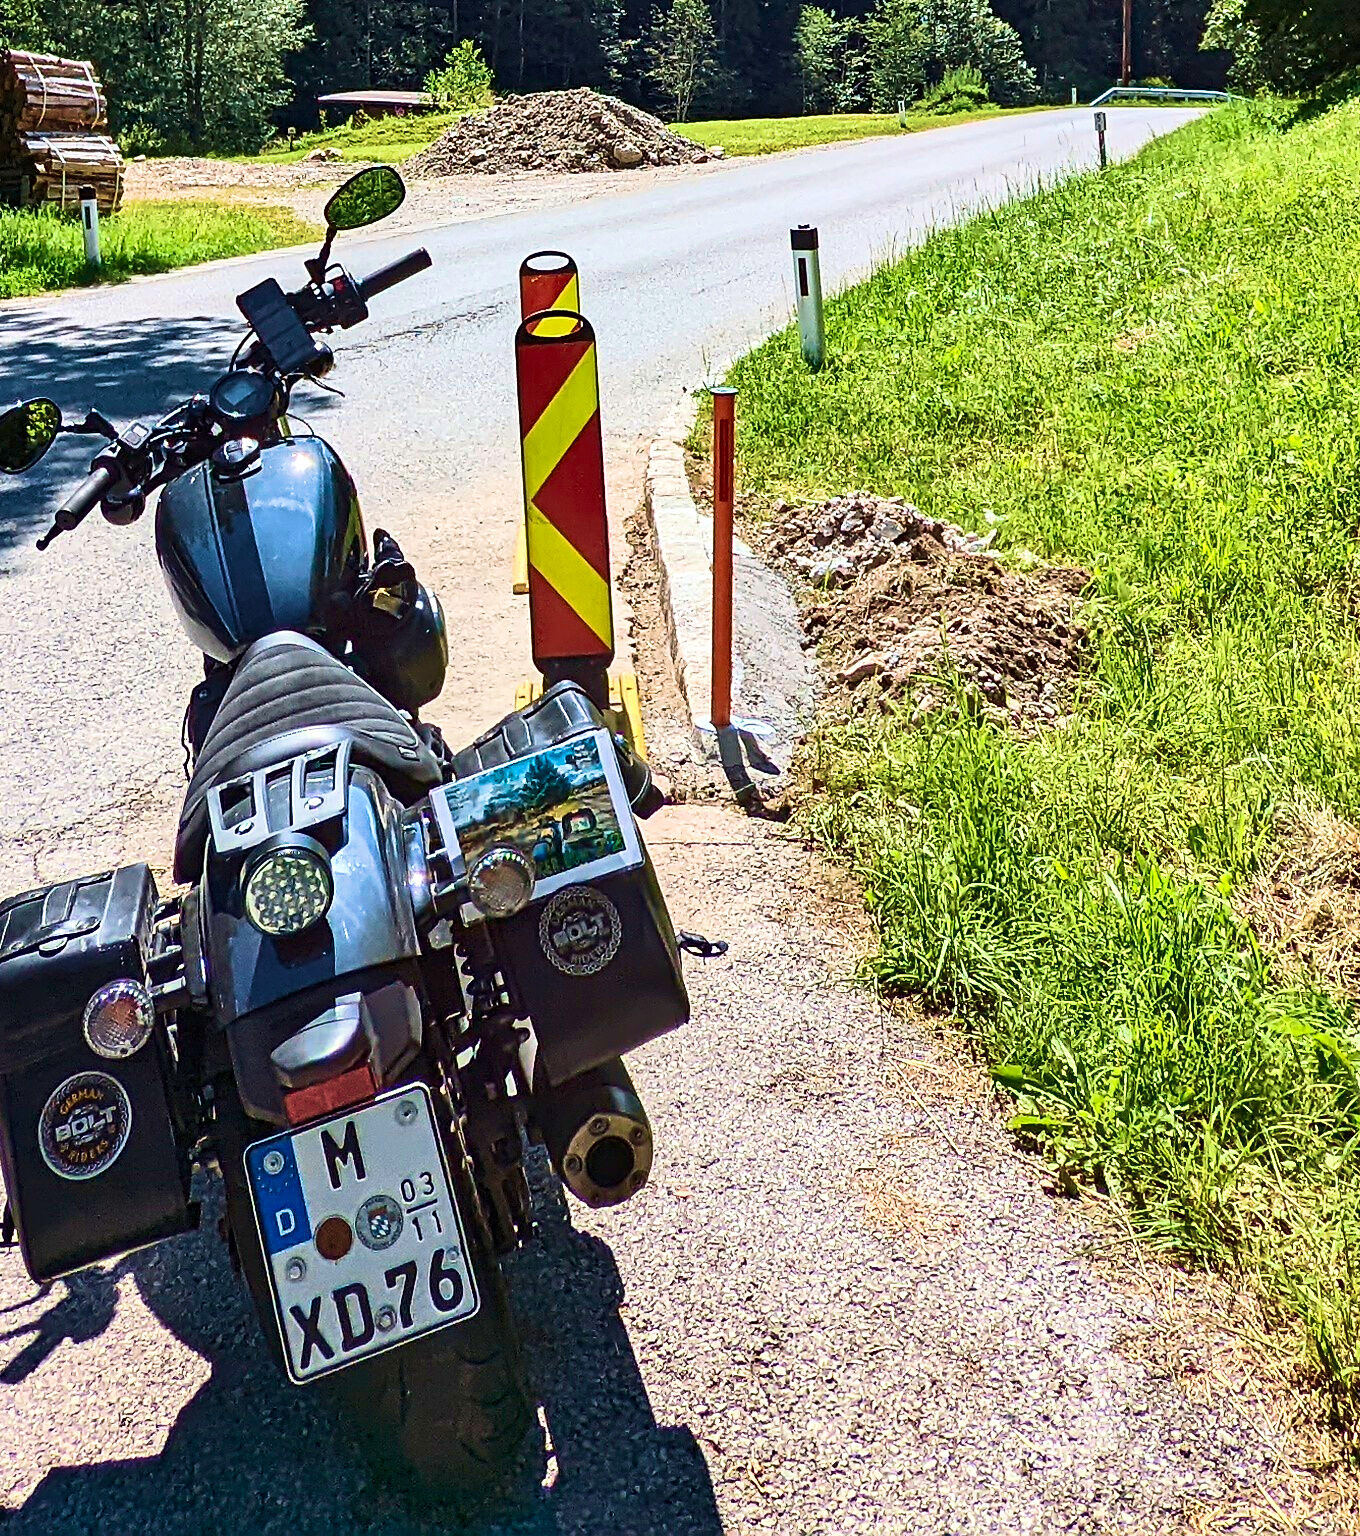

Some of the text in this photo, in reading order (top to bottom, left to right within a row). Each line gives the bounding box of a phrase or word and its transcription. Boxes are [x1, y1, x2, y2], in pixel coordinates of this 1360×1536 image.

[55, 1105, 117, 1143] BOLT
[320, 1120, 367, 1190] M
[400, 1171, 435, 1203] 03
[275, 1208, 296, 1237] D
[411, 1209, 442, 1242] 11
[288, 1248, 464, 1370] XD 76
